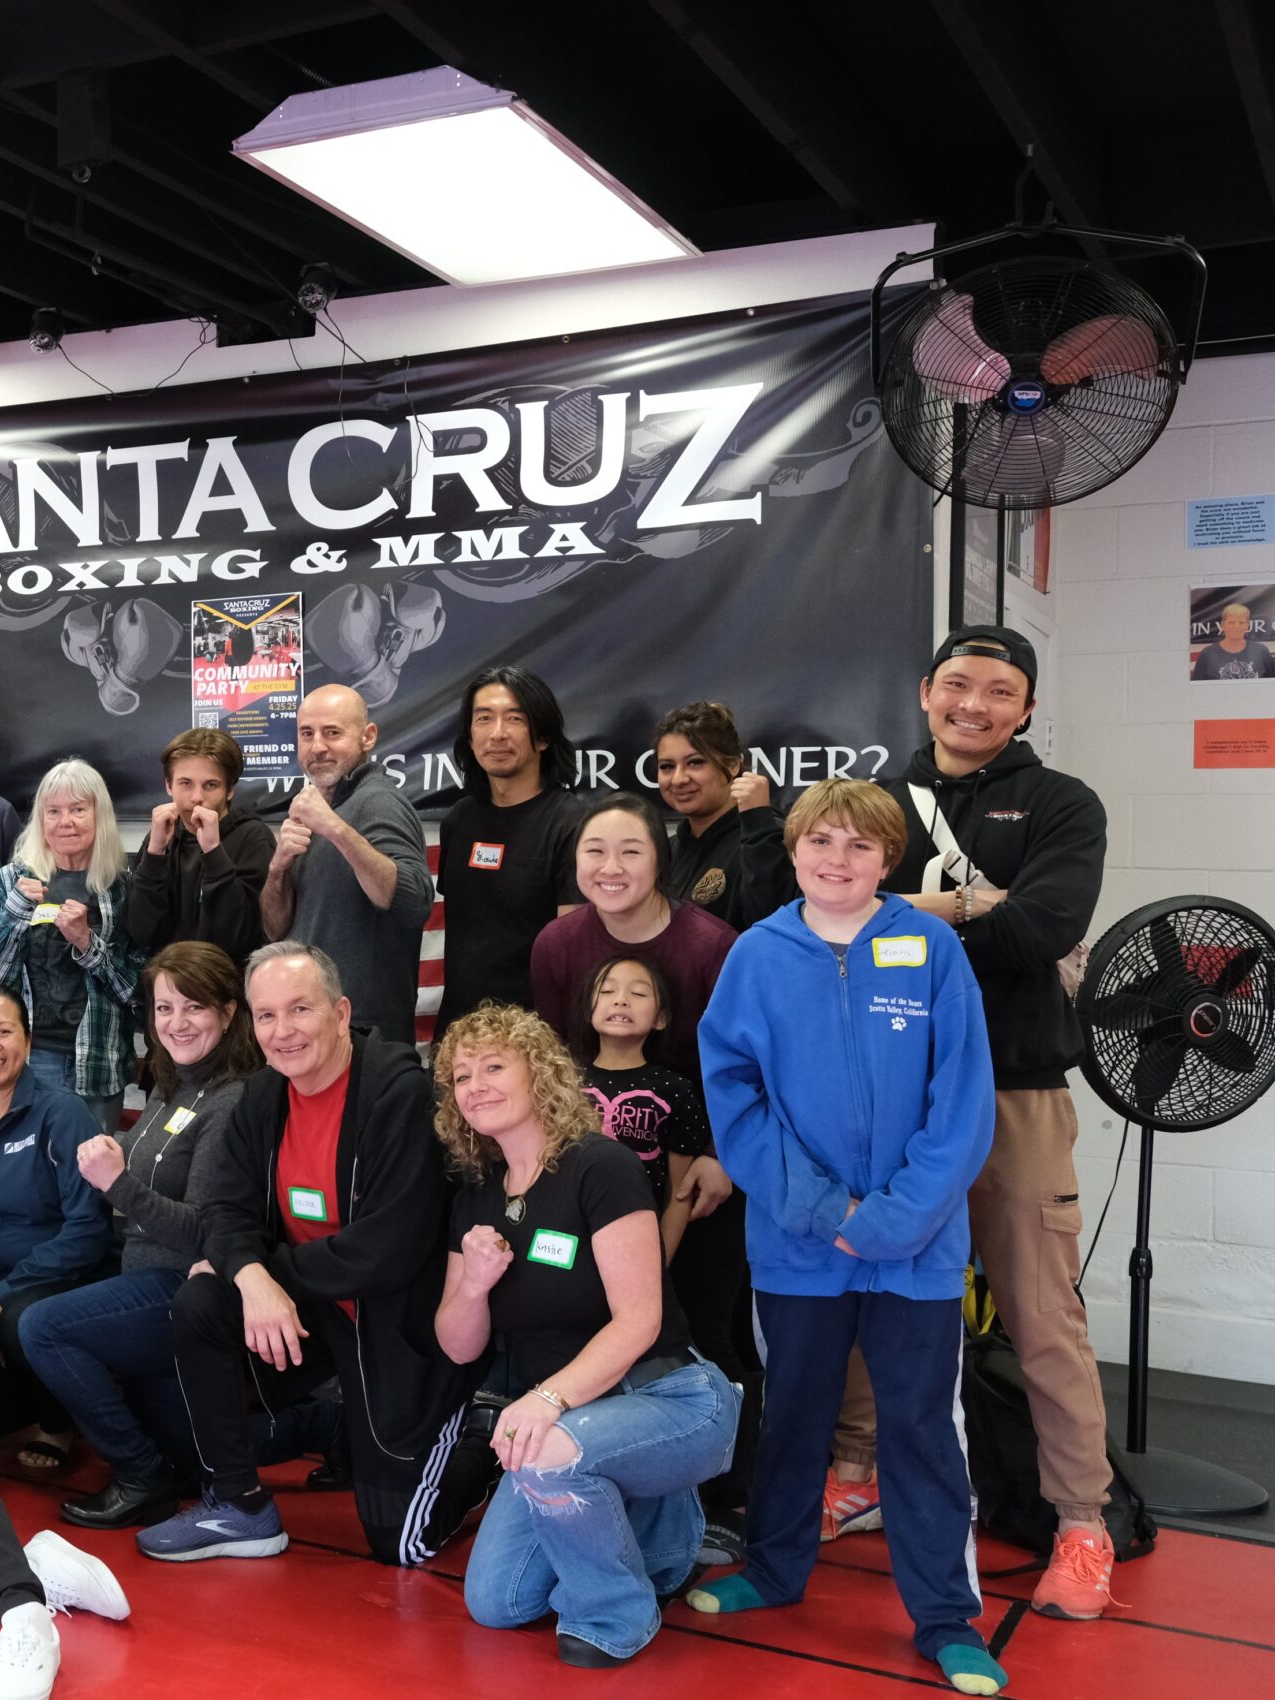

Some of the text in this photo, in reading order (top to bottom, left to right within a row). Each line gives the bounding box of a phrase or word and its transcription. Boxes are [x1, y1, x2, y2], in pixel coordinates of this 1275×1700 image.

[286, 382, 766, 530] CRUZ
[289, 543, 349, 575] &
[376, 521, 607, 570] MMA
[1192, 622, 1210, 635] IN
[194, 663, 299, 681] COMMUNITY
[197, 680, 250, 695] PARTY
[269, 695, 298, 703] FRIDAY
[244, 744, 294, 753] FRIEND OR
[246, 756, 290, 765] MEMBER
[423, 753, 465, 791] IN
[904, 1007, 928, 1016] California
